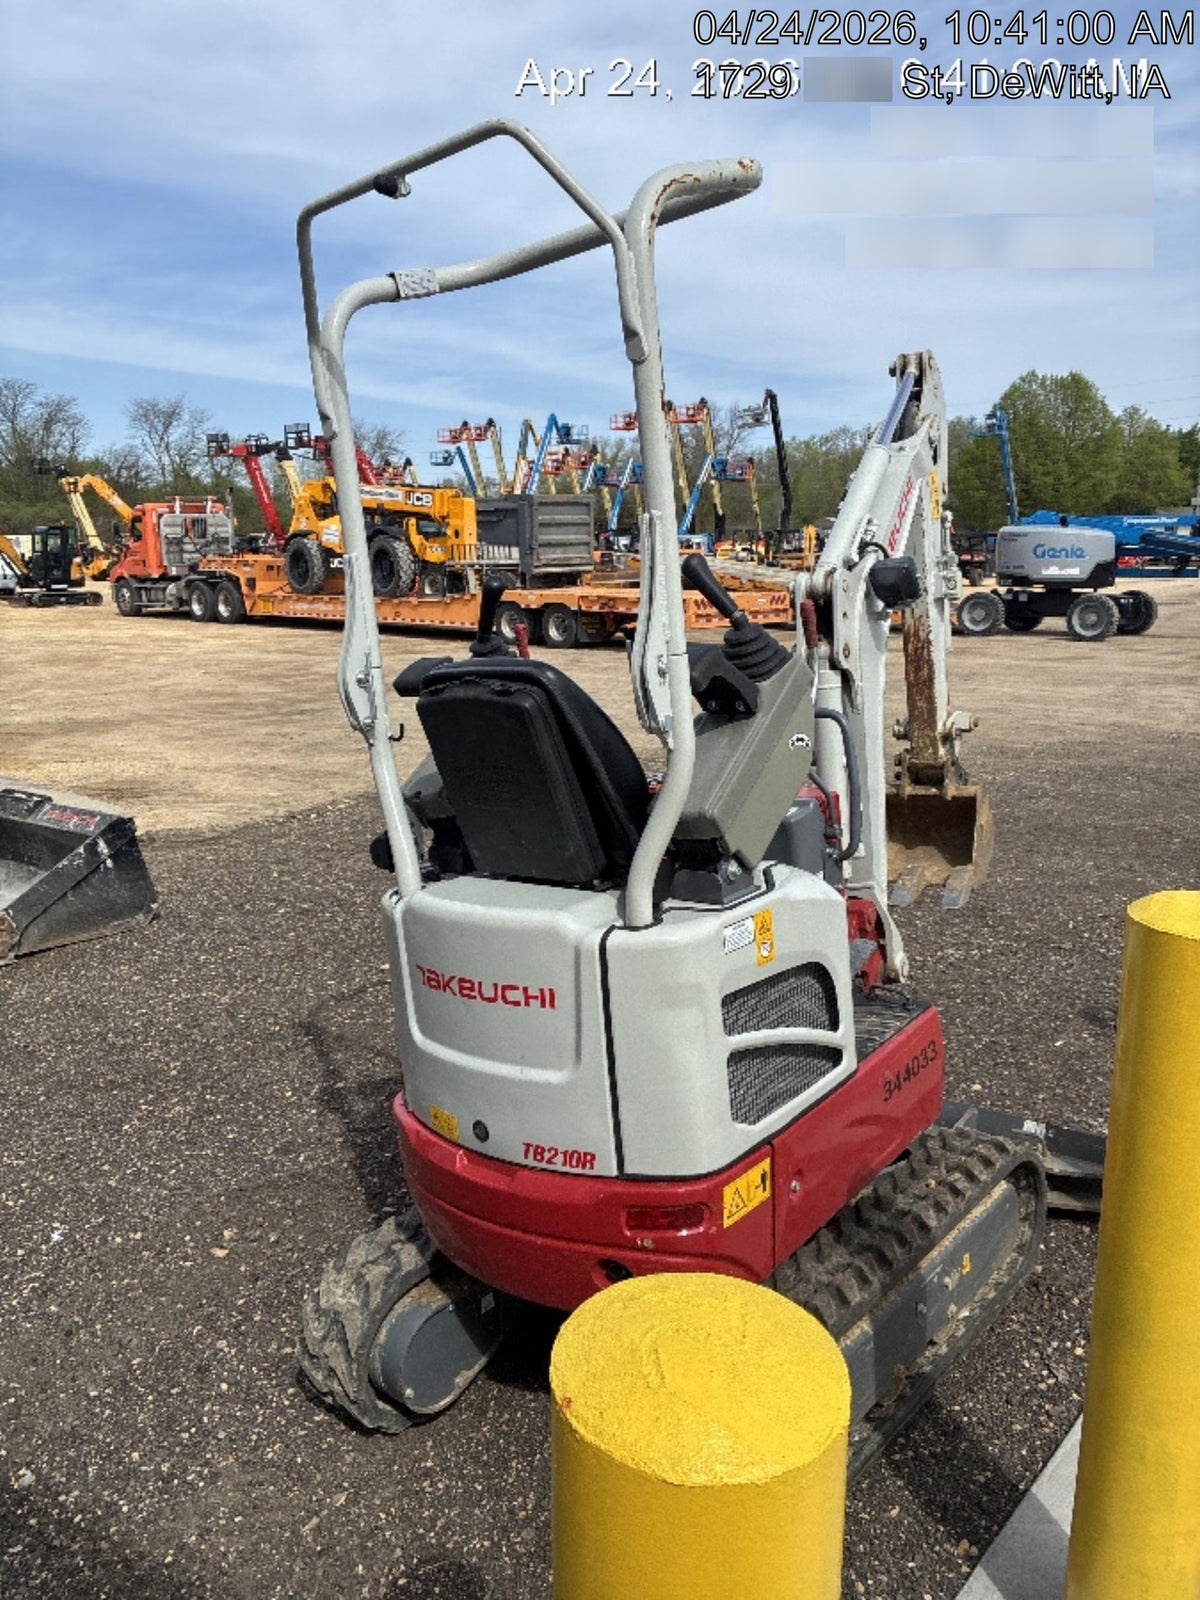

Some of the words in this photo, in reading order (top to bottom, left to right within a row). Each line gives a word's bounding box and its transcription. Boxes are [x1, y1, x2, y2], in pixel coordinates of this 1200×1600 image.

[405, 491, 433, 506] JCB
[1033, 543, 1087, 559] Genie
[329, 557, 344, 568] JC
[882, 1040, 938, 1103] 344033
[522, 1141, 597, 1171] TB210R
